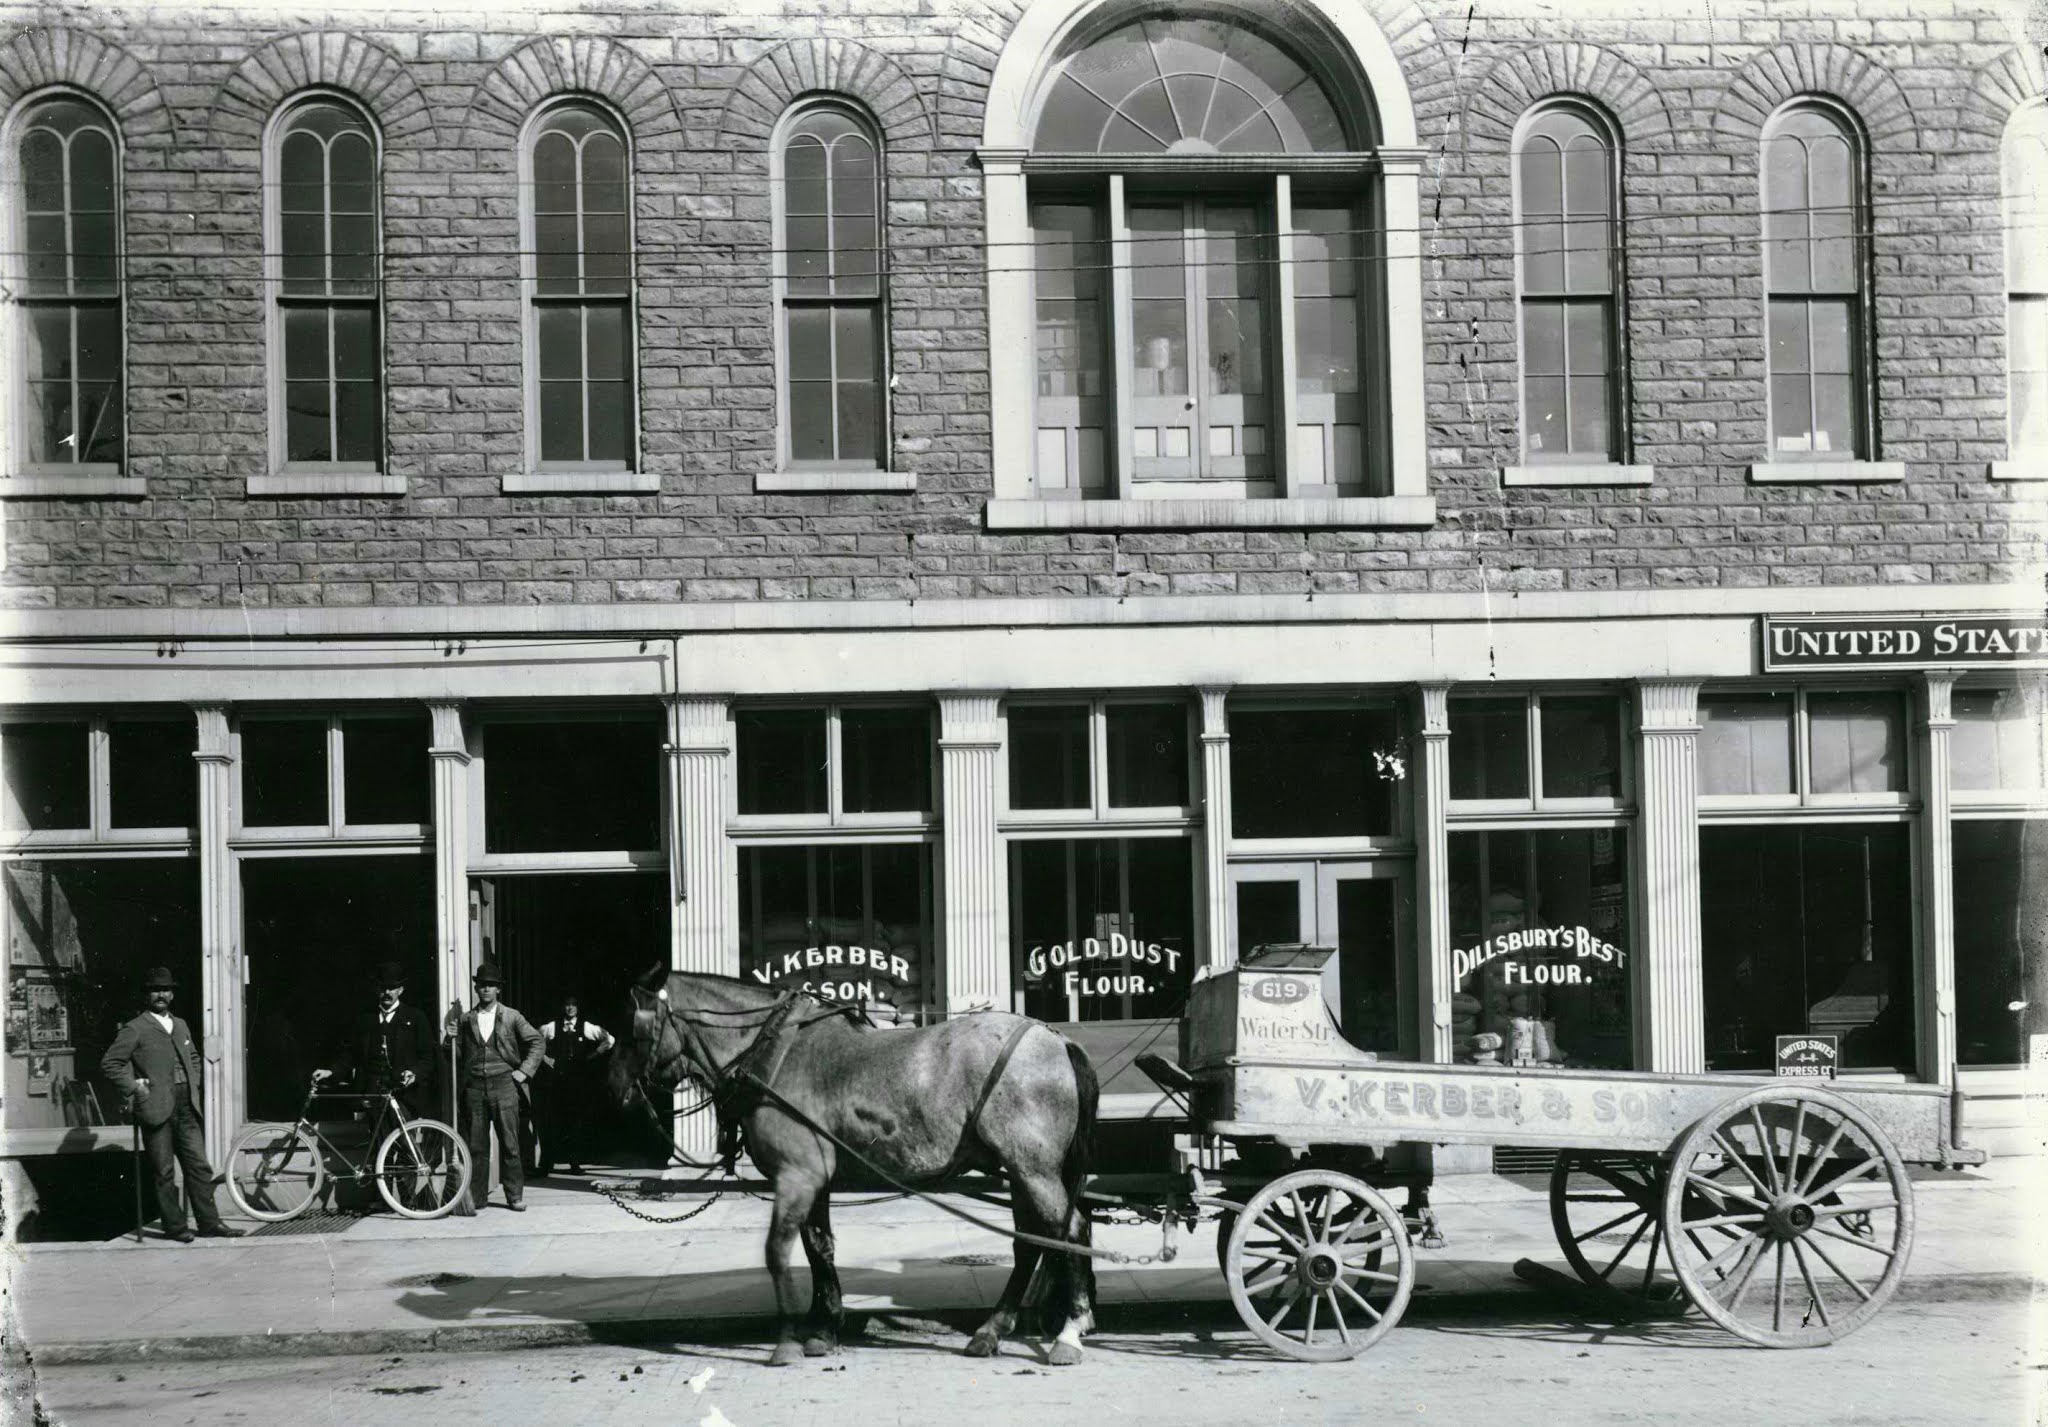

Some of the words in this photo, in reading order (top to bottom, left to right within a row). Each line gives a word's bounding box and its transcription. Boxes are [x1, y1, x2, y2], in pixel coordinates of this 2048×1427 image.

[1771, 626, 1921, 656] UNITED
[783, 945, 909, 982] KERBER
[1029, 937, 1101, 976] GOLD
[1110, 932, 1181, 973] DUST
[1453, 925, 1575, 994] PILLSBURY'S
[1576, 925, 1627, 969] BEST
[1064, 970, 1155, 997] FLOUR.
[1505, 961, 1593, 985] FLOUR.
[1240, 1016, 1298, 1040] Water
[1779, 1040, 1807, 1059] UNITED
[1808, 1040, 1837, 1059] STATES
[1779, 1065, 1819, 1076] EXPRESS
[1349, 1079, 1524, 1124] KERBER
[1543, 1091, 1573, 1121] &
